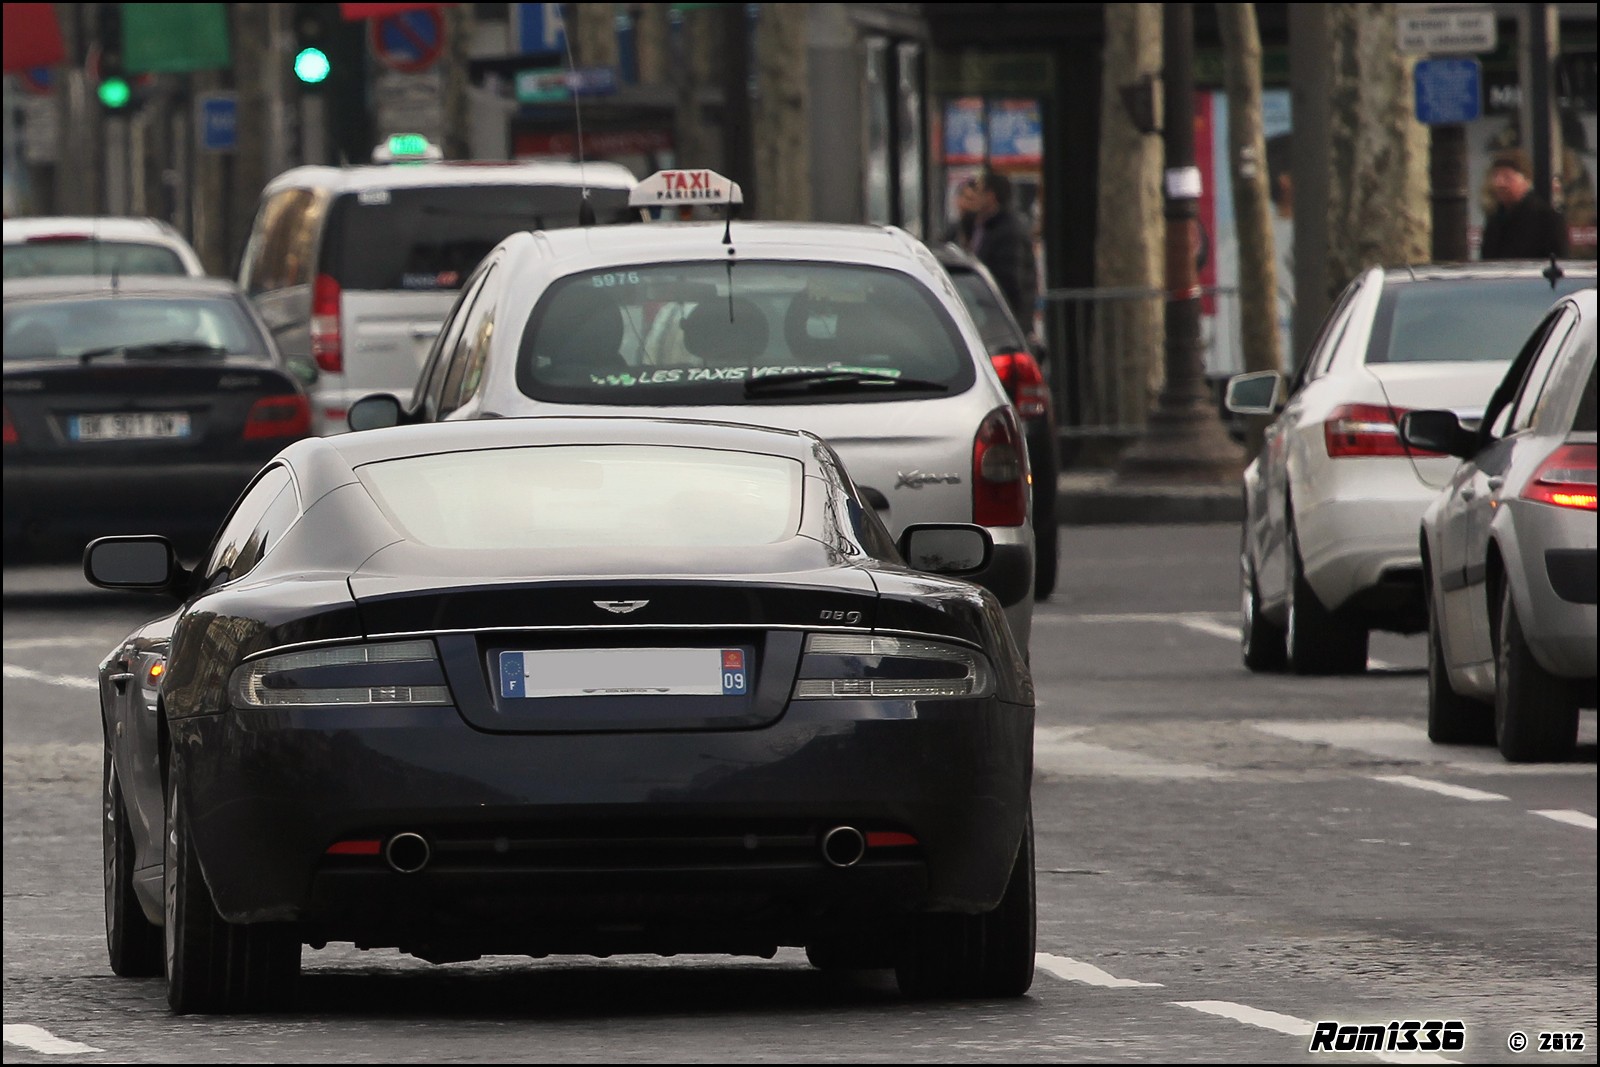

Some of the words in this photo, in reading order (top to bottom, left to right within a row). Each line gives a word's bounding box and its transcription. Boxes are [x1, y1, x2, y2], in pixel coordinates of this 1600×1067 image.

[661, 172, 711, 189] TAXI
[656, 189, 722, 200] PARISIEN
[592, 271, 640, 288] 5976
[639, 369, 684, 383] LES
[687, 366, 749, 382] TAXIS
[820, 610, 861, 624] DB9
[509, 680, 517, 691] F
[723, 672, 744, 689] 09
